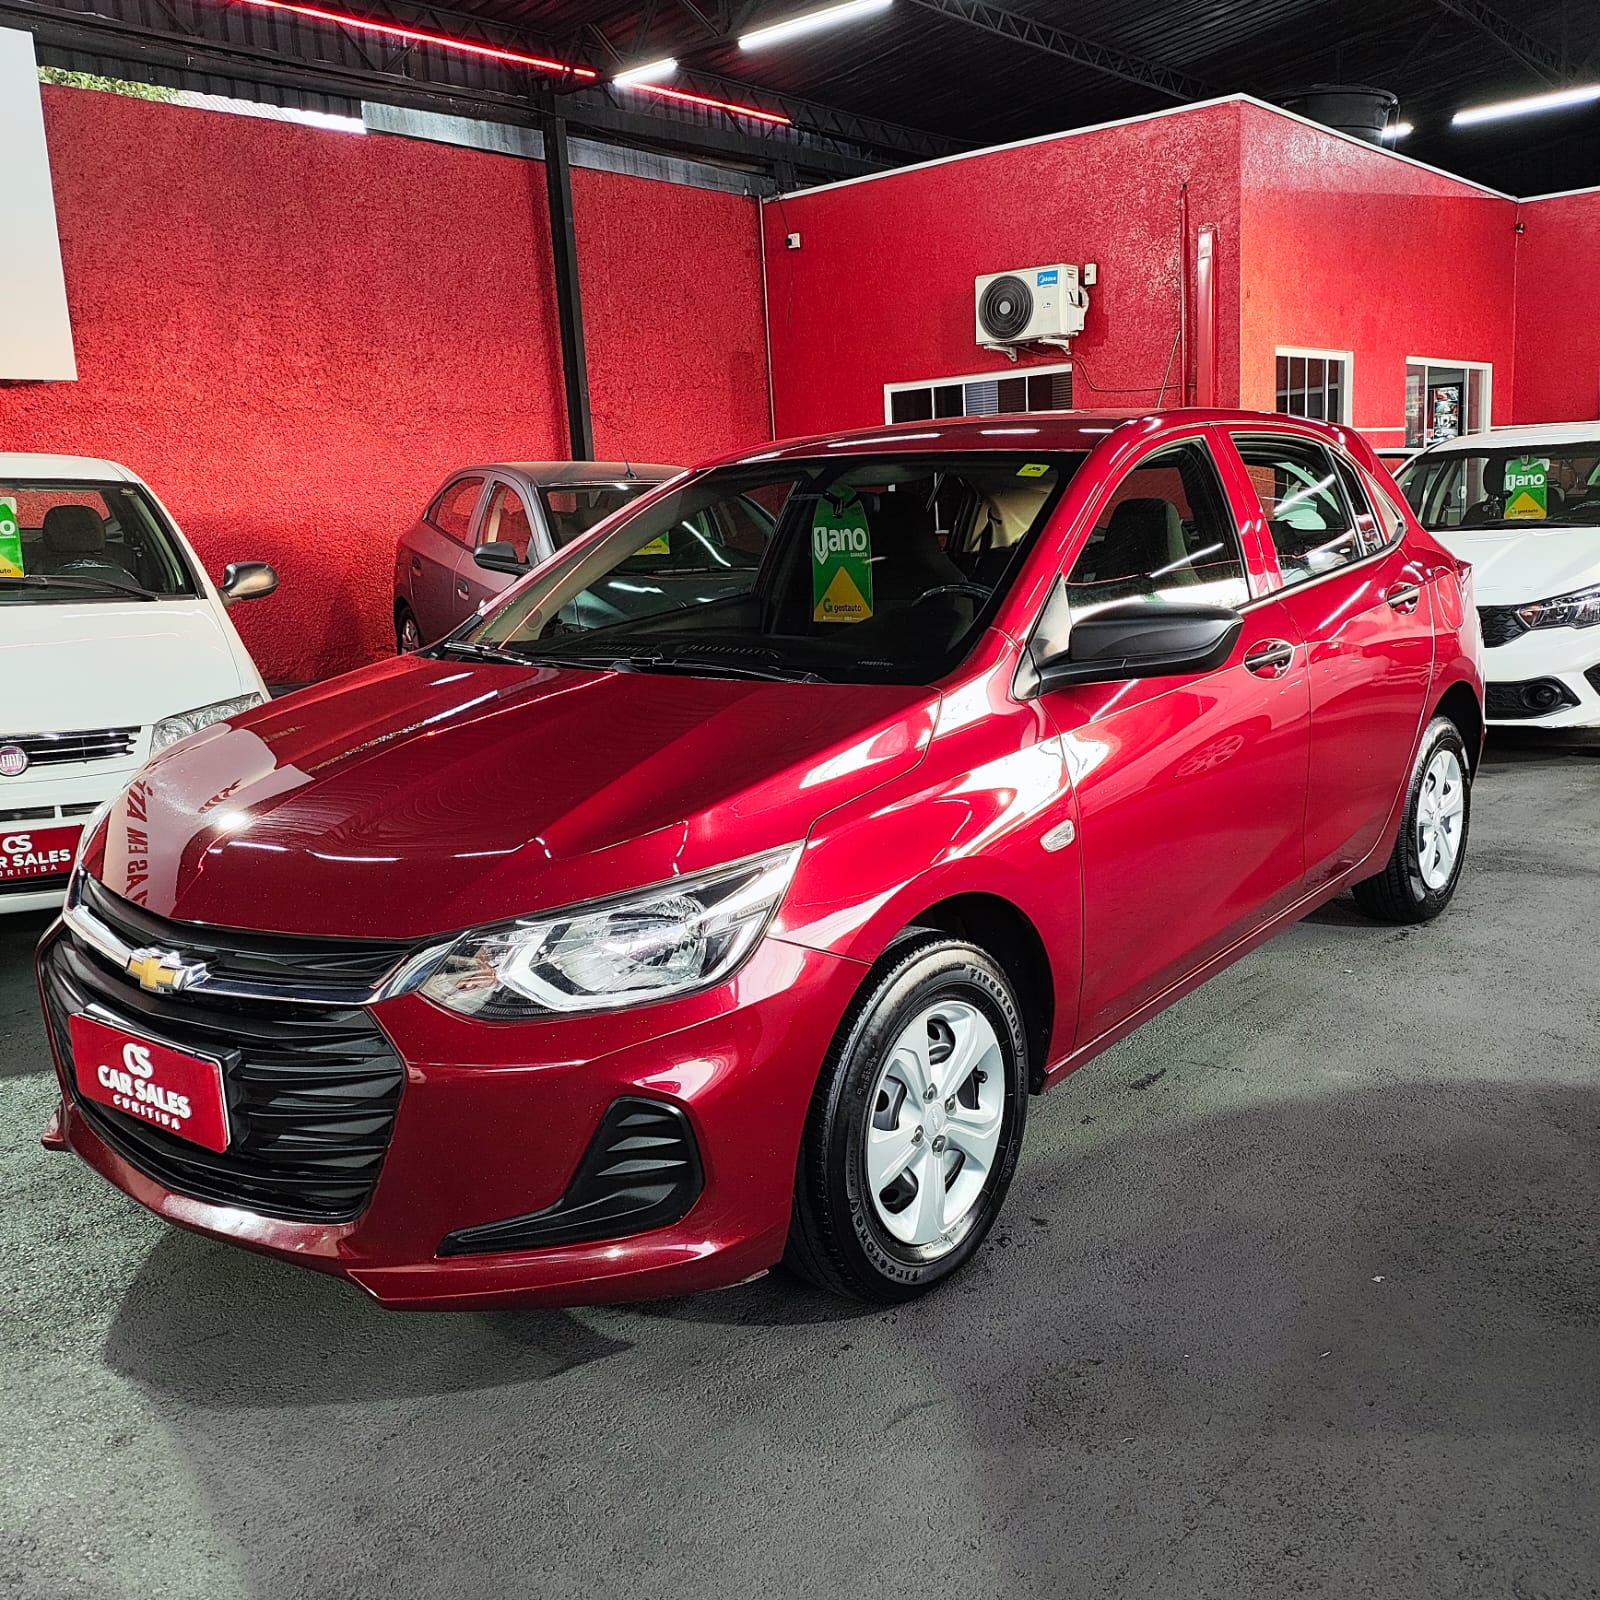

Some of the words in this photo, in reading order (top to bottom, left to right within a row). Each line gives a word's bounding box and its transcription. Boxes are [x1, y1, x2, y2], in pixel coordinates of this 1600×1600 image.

[2, 834, 33, 854] CS
[12, 848, 71, 867] SALES
[122, 1043, 154, 1078] CS
[97, 1065, 134, 1096] CAR
[134, 1078, 192, 1119] SALES
[113, 1094, 181, 1130] CURITIBA
